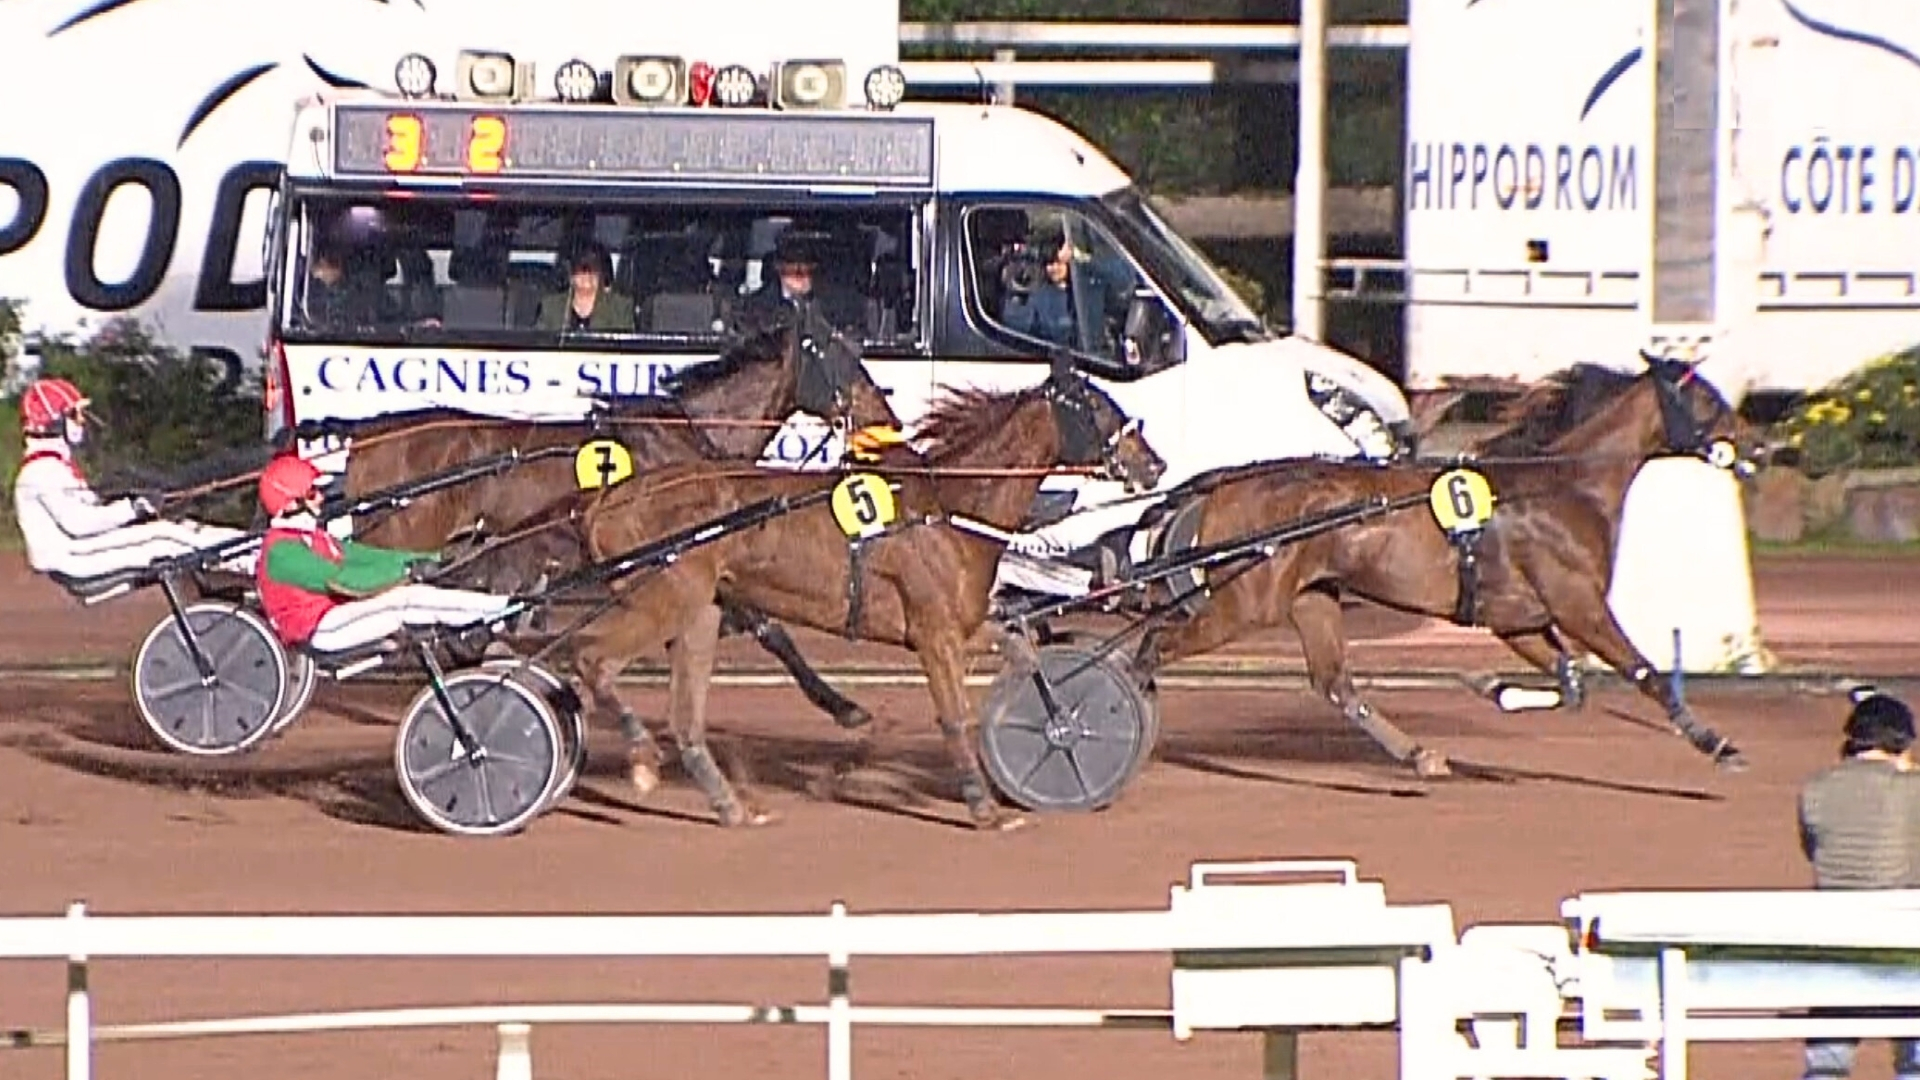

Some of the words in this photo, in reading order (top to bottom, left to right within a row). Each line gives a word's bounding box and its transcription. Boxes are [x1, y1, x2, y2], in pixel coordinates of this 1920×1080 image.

[385, 113, 422, 173] 3
[467, 115, 507, 174] 2
[1409, 142, 1637, 212] HIPPODROM
[1781, 135, 1876, 214] CÔTE
[1892, 147, 1920, 214] D
[317, 356, 531, 395] CAGNES
[594, 445, 618, 486] 7
[845, 478, 878, 525] 5
[1446, 475, 1475, 519] 6
